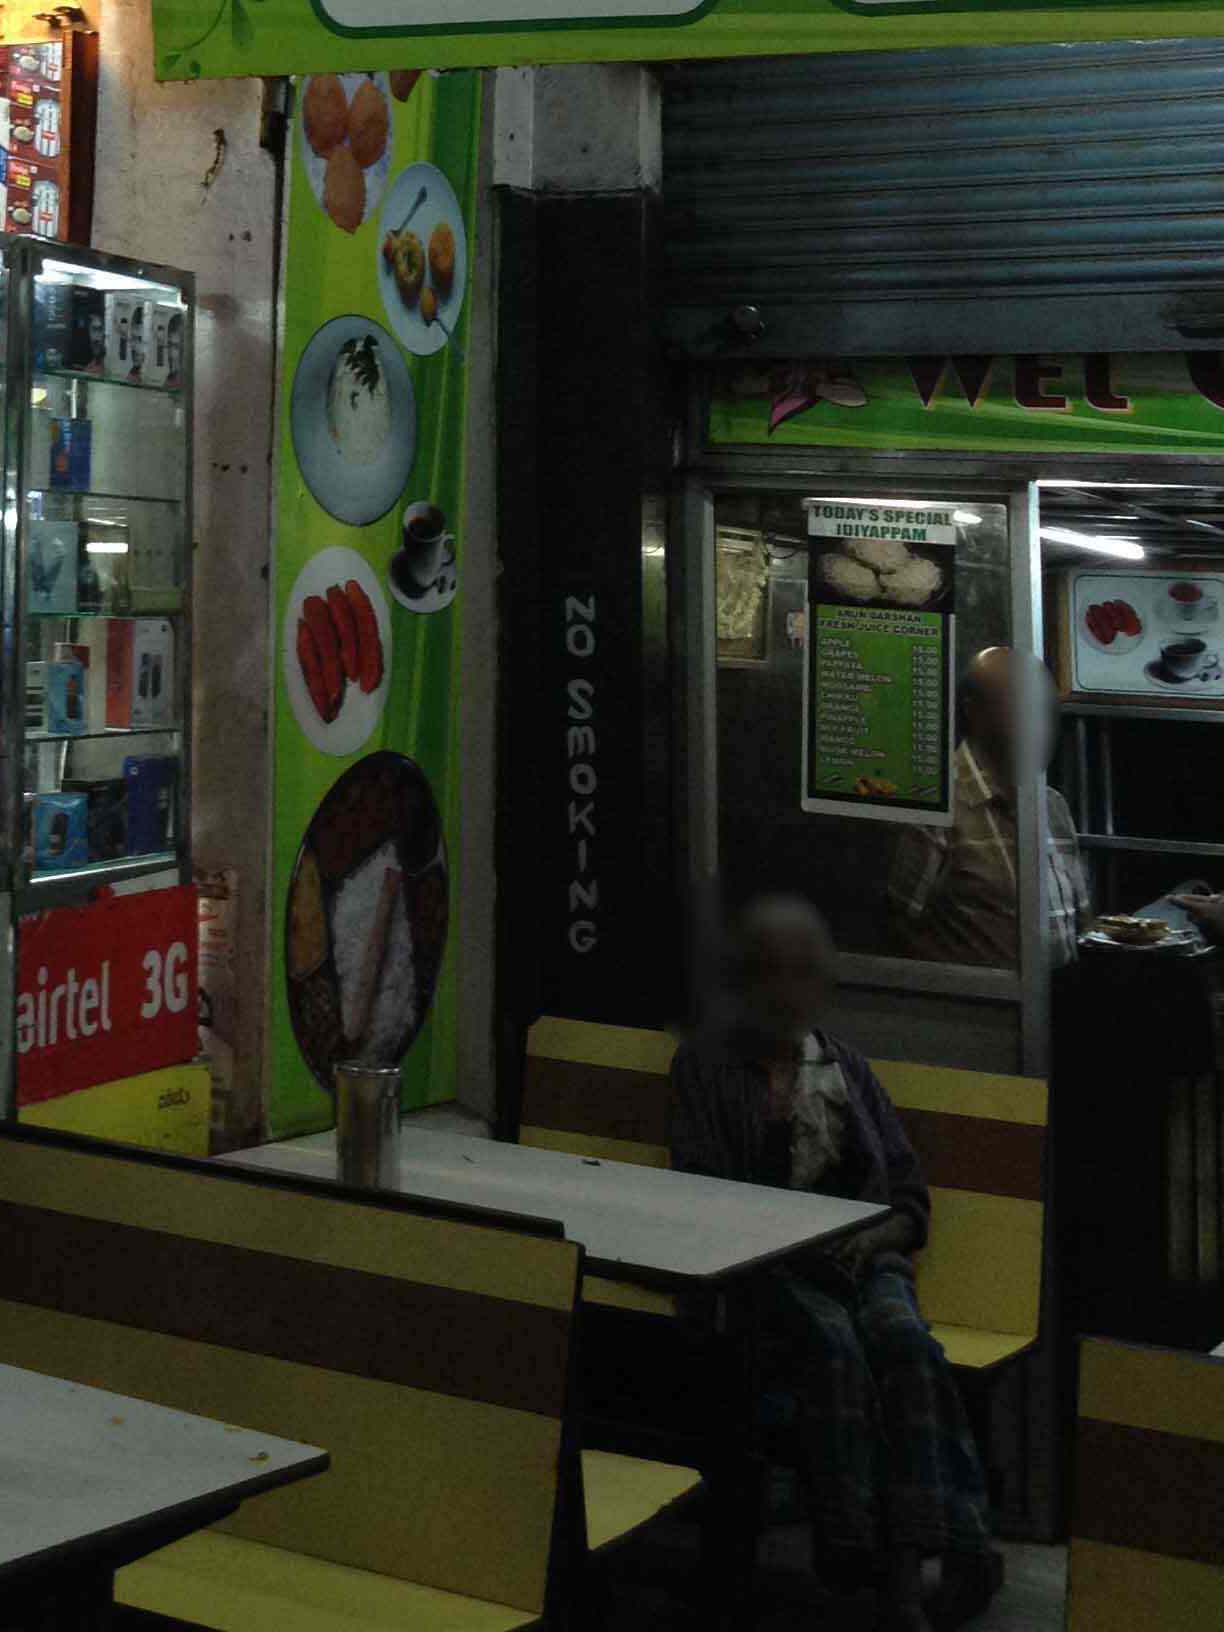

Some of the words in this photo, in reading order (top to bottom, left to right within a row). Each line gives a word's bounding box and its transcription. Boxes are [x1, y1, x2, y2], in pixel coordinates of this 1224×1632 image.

[813, 505, 879, 522] TODAY'S
[883, 509, 953, 526] SPECIAL
[836, 523, 927, 541] IDIYAPPAM
[564, 593, 597, 658] NO
[566, 678, 599, 954] SMOKING
[16, 960, 113, 1055] airtel
[139, 940, 189, 1020] 3G
